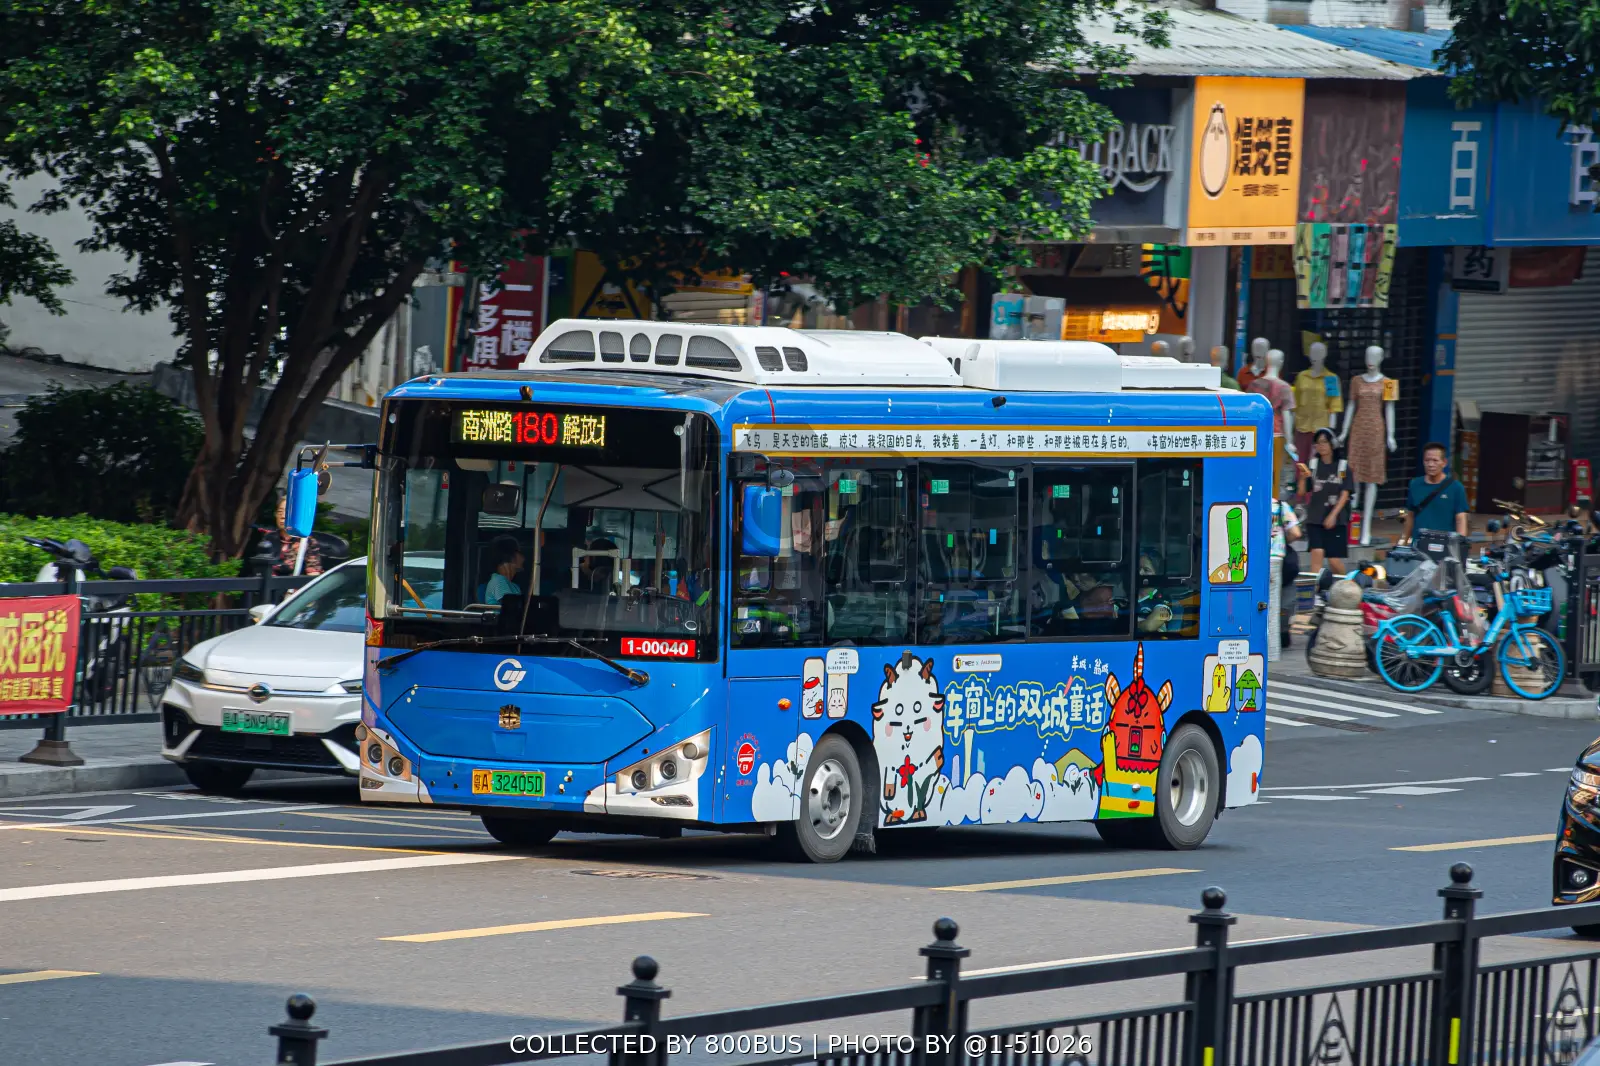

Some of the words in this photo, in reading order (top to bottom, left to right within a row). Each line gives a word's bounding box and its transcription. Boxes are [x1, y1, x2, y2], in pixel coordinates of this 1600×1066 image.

[462, 410, 512, 442] 南洲路
[512, 412, 558, 444] 180
[627, 640, 689, 655] 1-00040
[946, 682, 1104, 738] 车窗上的双城童话
[495, 774, 543, 792] 32405D
